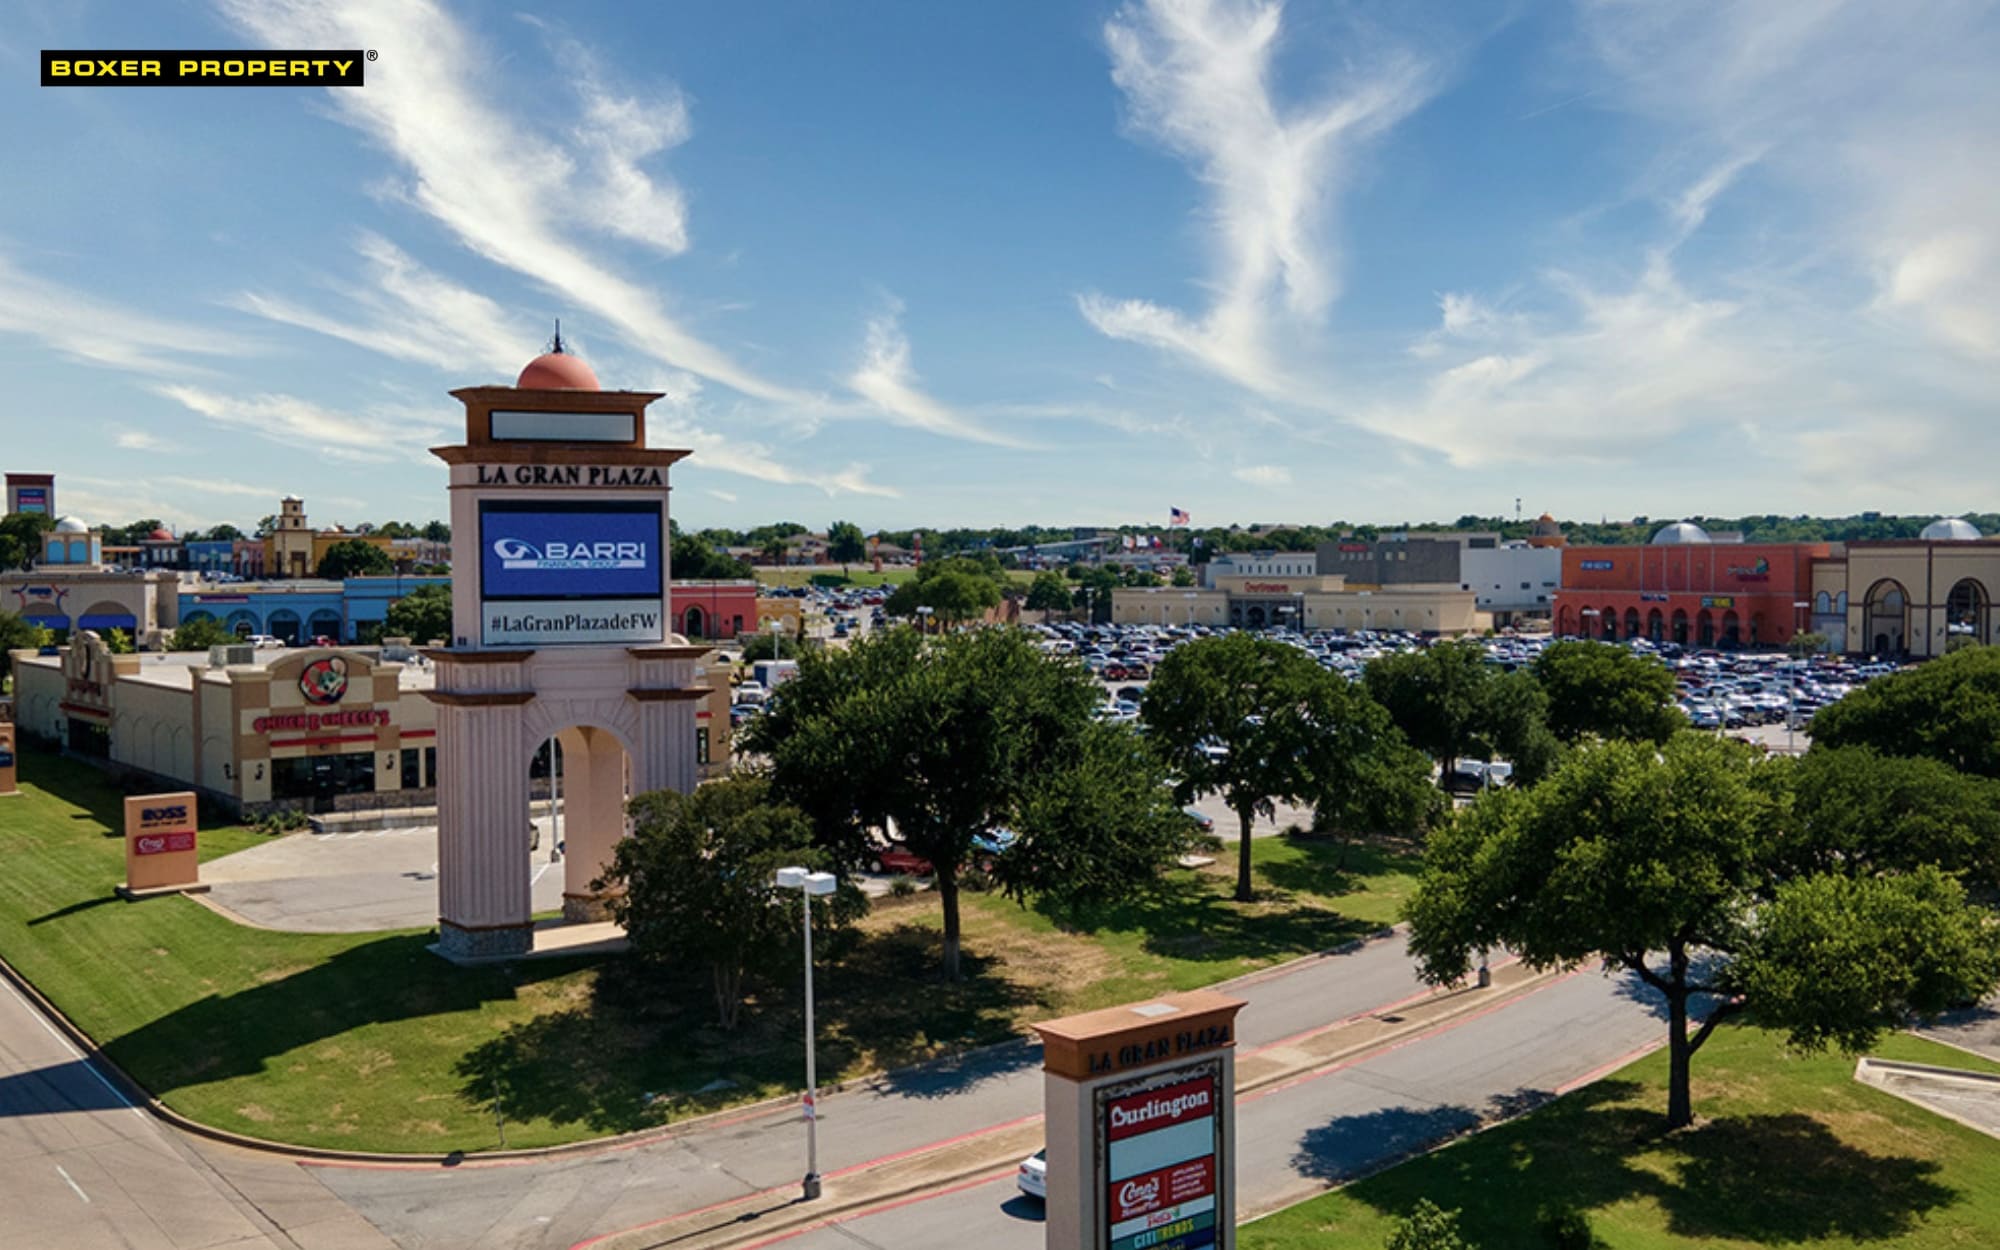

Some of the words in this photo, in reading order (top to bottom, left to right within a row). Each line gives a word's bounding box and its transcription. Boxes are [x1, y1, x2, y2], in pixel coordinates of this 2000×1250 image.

[478, 466, 507, 483] LA
[516, 466, 580, 484] GRAN
[590, 467, 662, 486] PLAZA
[546, 542, 645, 559] BARRI
[491, 613, 658, 632] #LaGranPlazadeFW
[1089, 1050, 1113, 1073] LA
[1119, 1038, 1170, 1067] GRAN
[1176, 1024, 1230, 1052] PLAZA
[1111, 1089, 1209, 1128] Burlington
